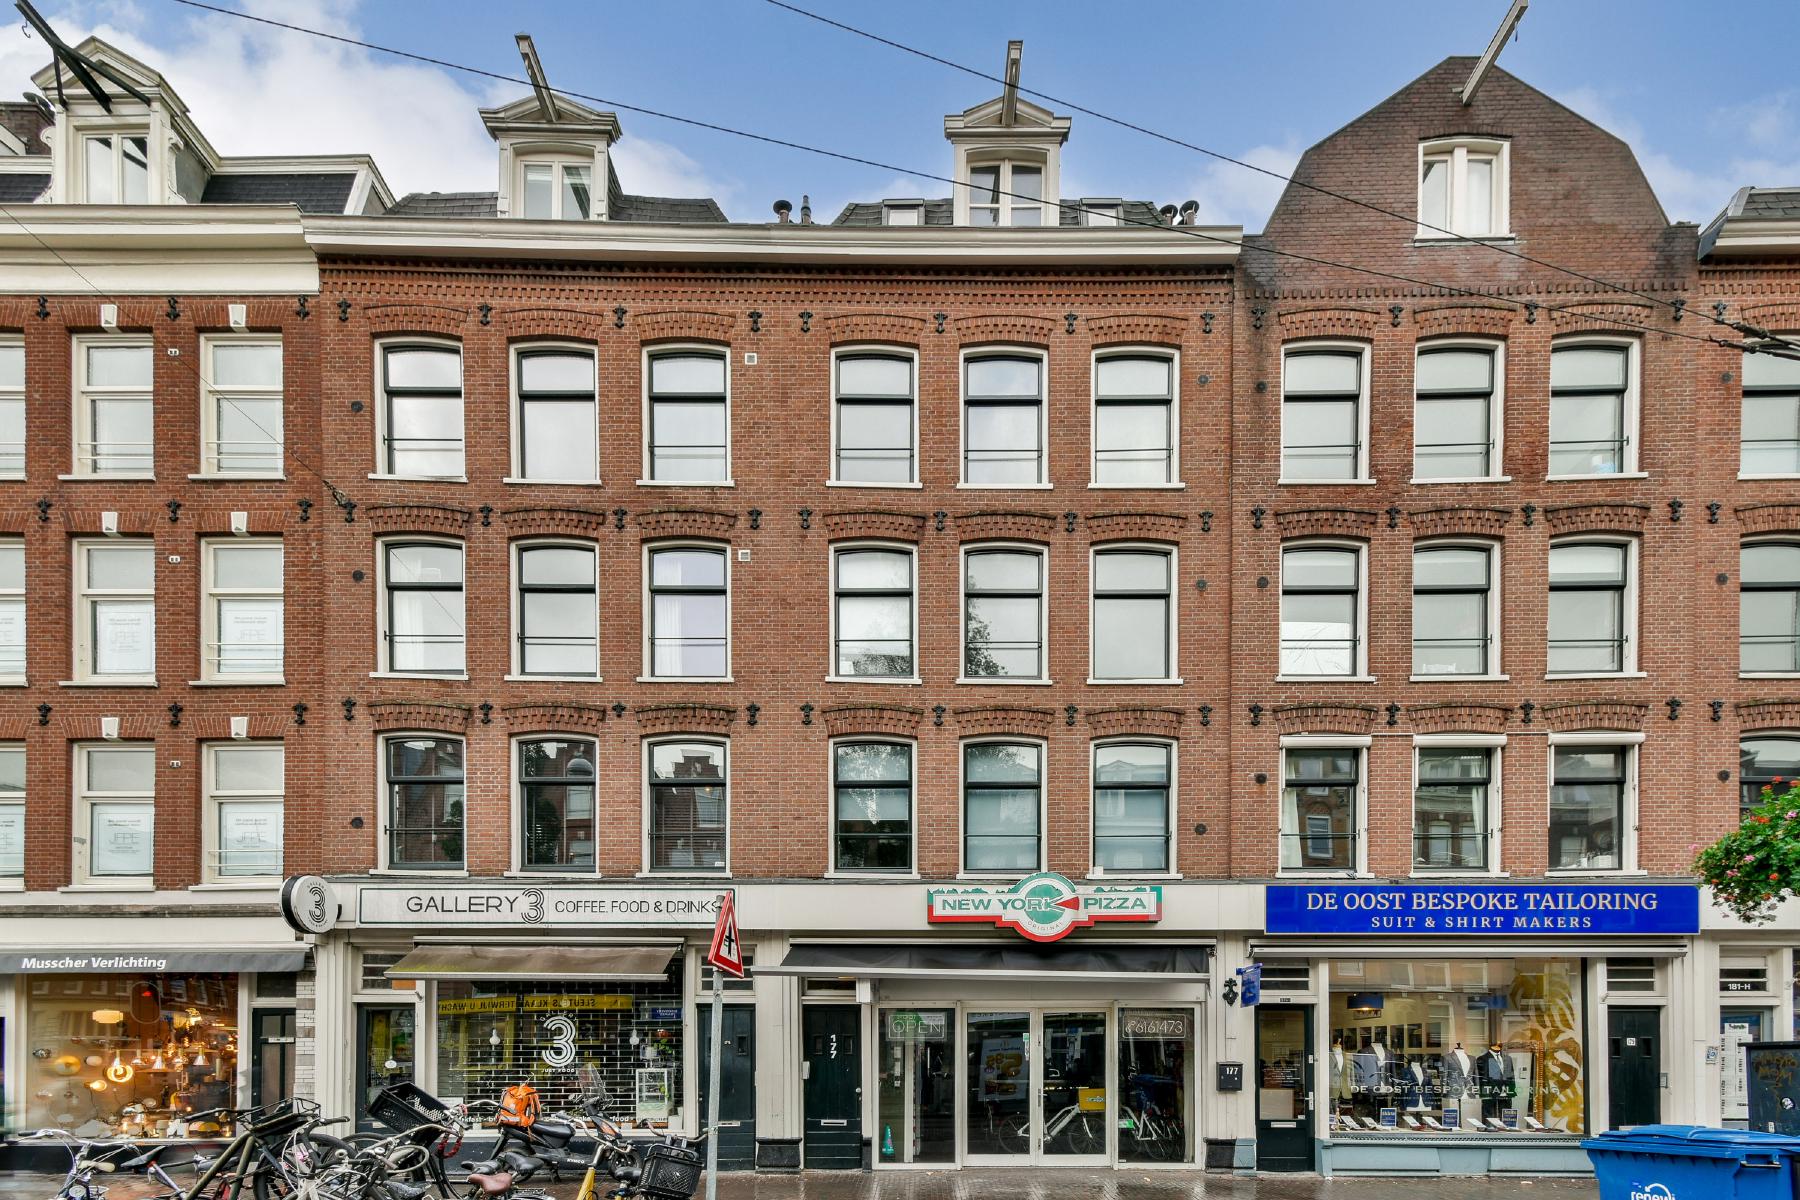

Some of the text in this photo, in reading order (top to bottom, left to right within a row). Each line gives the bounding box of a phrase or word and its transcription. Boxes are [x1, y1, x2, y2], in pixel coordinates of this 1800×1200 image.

[309, 886, 326, 923] 3
[406, 896, 519, 913] GALLERY
[520, 888, 545, 924] 3
[611, 900, 650, 913] FOOD
[653, 900, 663, 913] &
[942, 897, 1147, 912] NEW YORK PIZZA
[1306, 893, 1658, 910] DE OOST BESPOKE TAILORING
[1371, 916, 1592, 928] SUIT & SHIRT MAKERS
[21, 956, 167, 970] Musscher Verlichting
[892, 1020, 941, 1034] OPEN
[542, 1016, 576, 1067] 3
[1226, 1067, 1239, 1075] 177
[1350, 1085, 1369, 1094] DE
